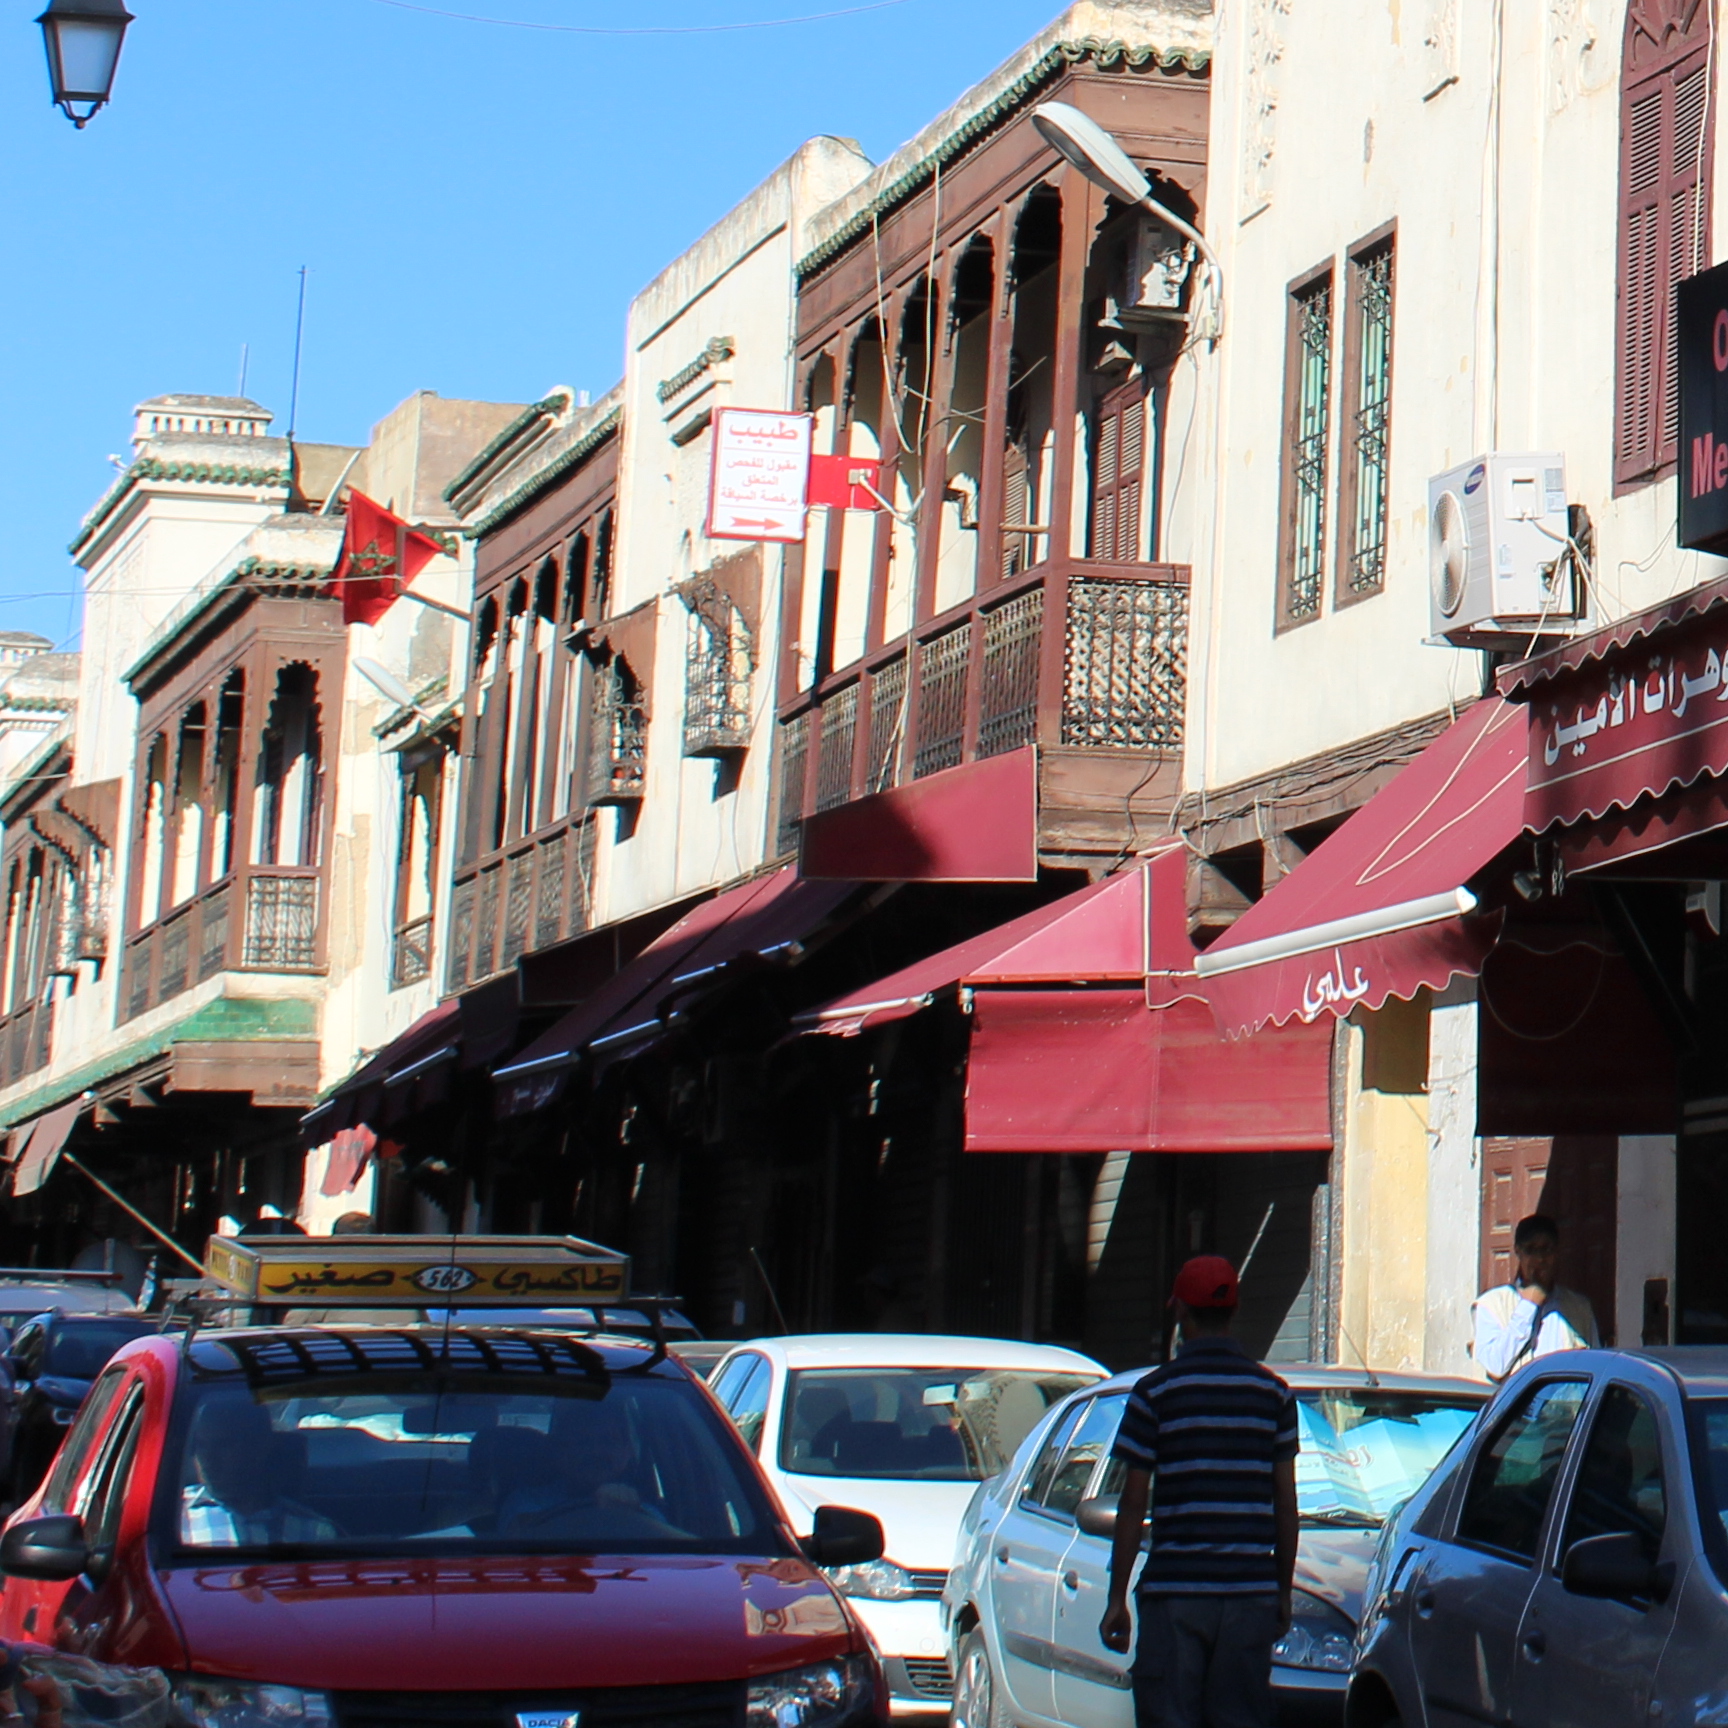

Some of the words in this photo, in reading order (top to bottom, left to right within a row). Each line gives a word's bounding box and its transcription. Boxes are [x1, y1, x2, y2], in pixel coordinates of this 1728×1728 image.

[729, 421, 799, 447] طبيب
[1544, 667, 1636, 766] الأمين
[263, 1263, 395, 1294] صغير
[428, 1269, 464, 1288] 562
[492, 1266, 621, 1296] طاكسي
